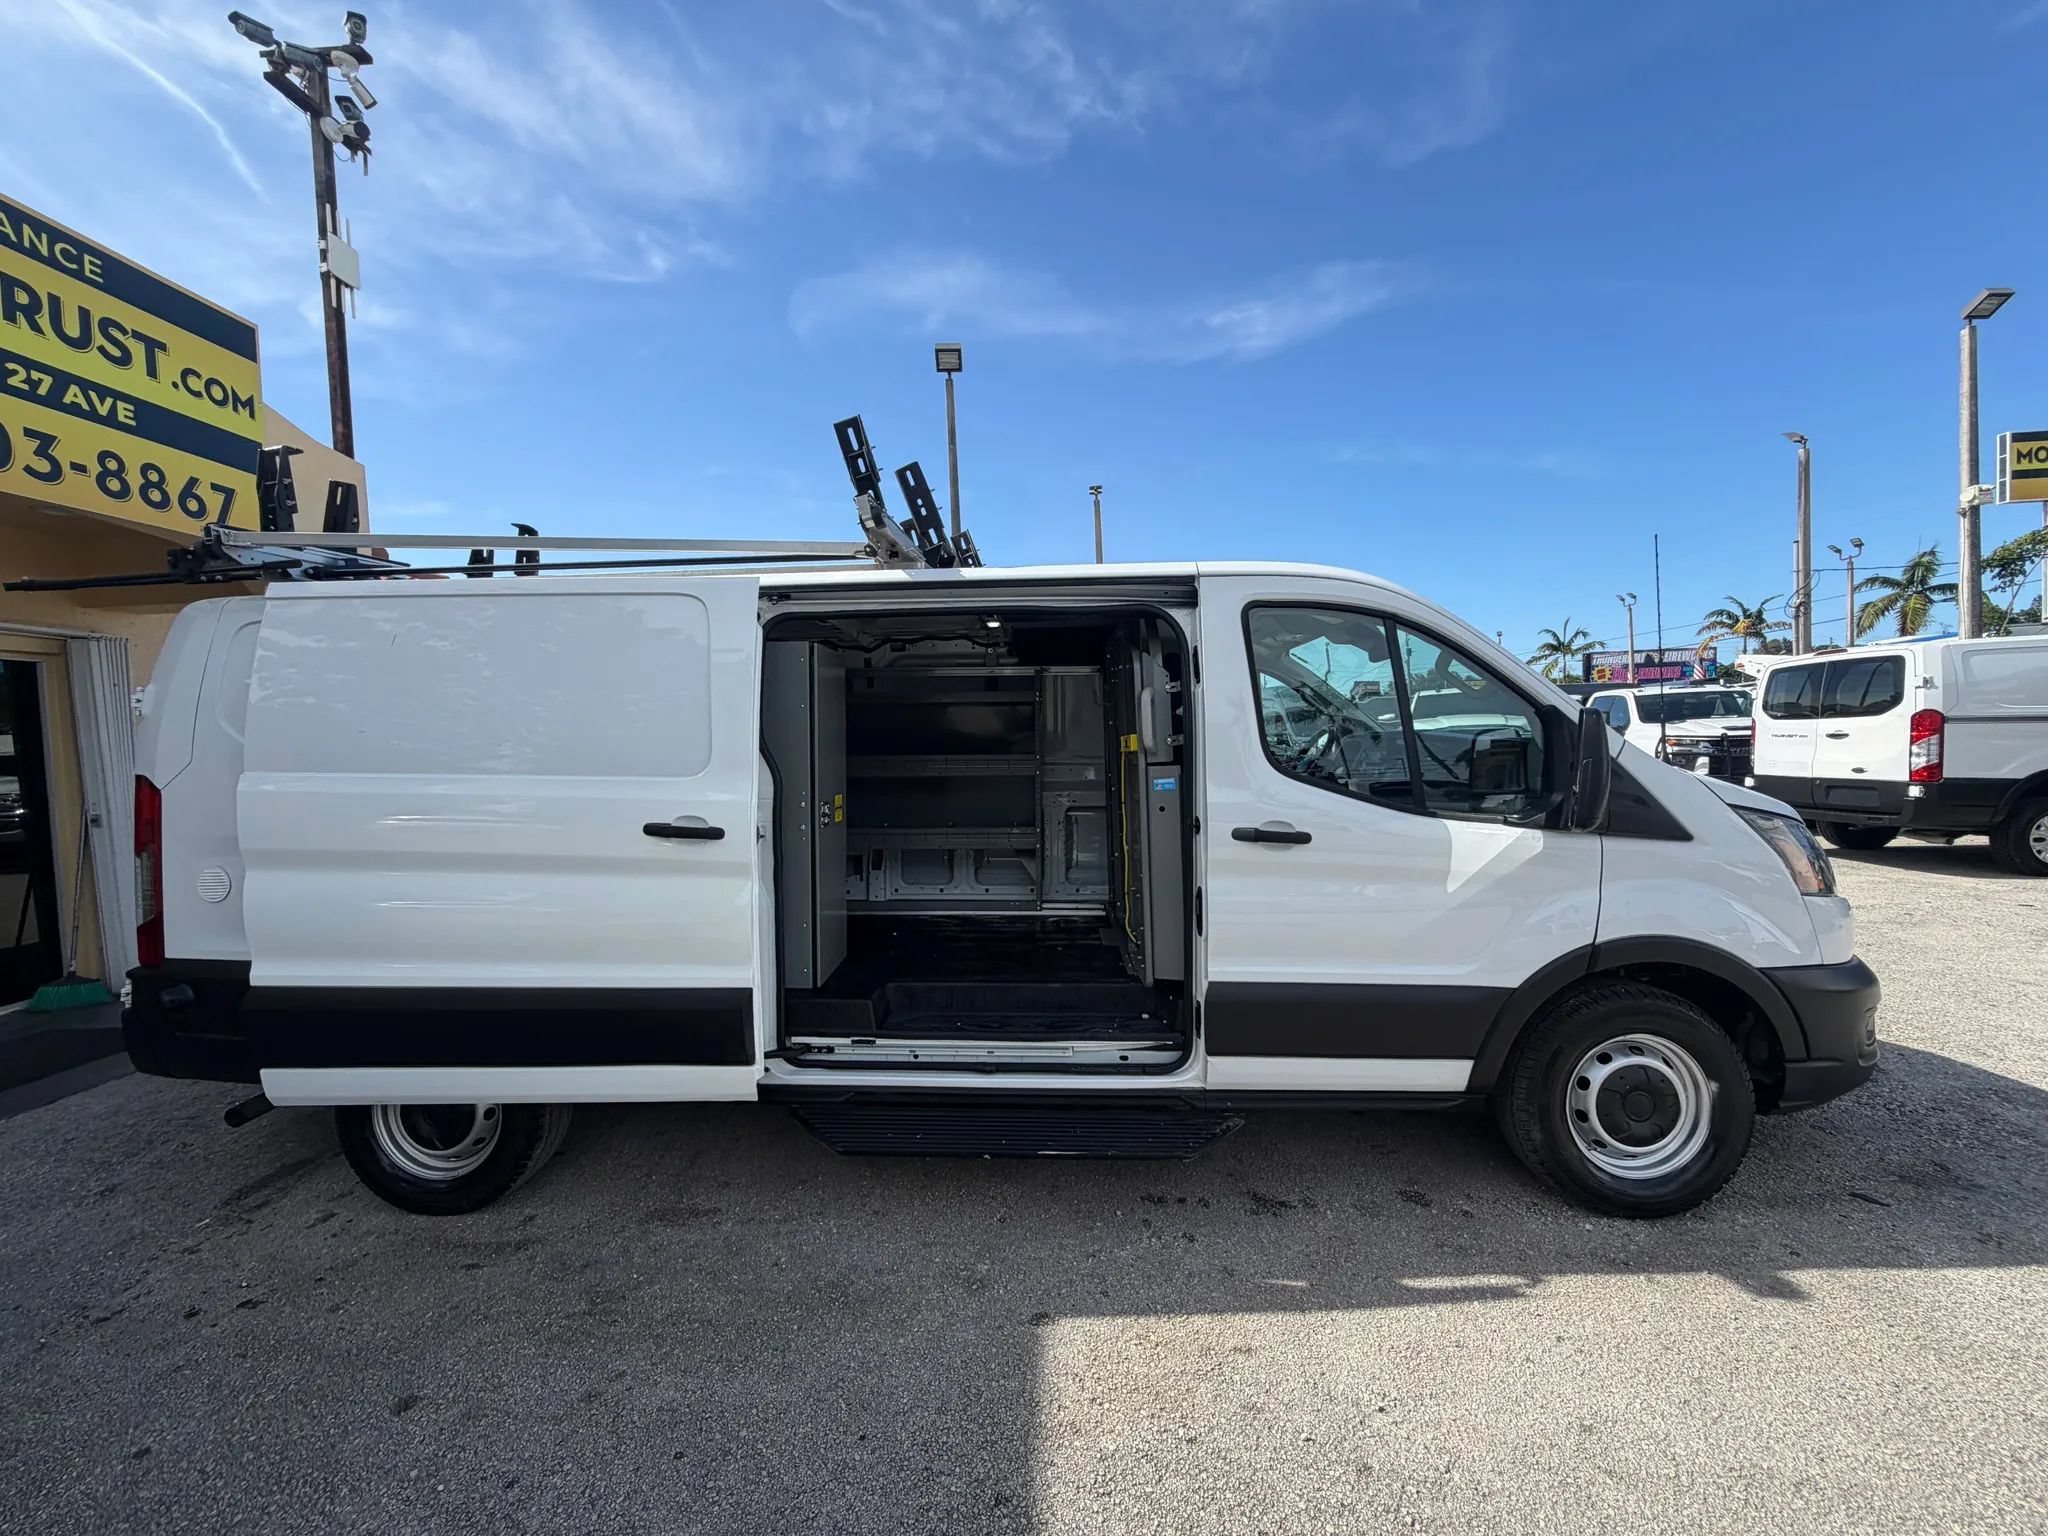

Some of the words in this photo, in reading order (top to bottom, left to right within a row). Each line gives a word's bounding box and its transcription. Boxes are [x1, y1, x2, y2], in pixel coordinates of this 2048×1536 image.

[4, 362, 54, 397] 27
[62, 383, 137, 427] AVE
[2016, 445, 2048, 465] MO
